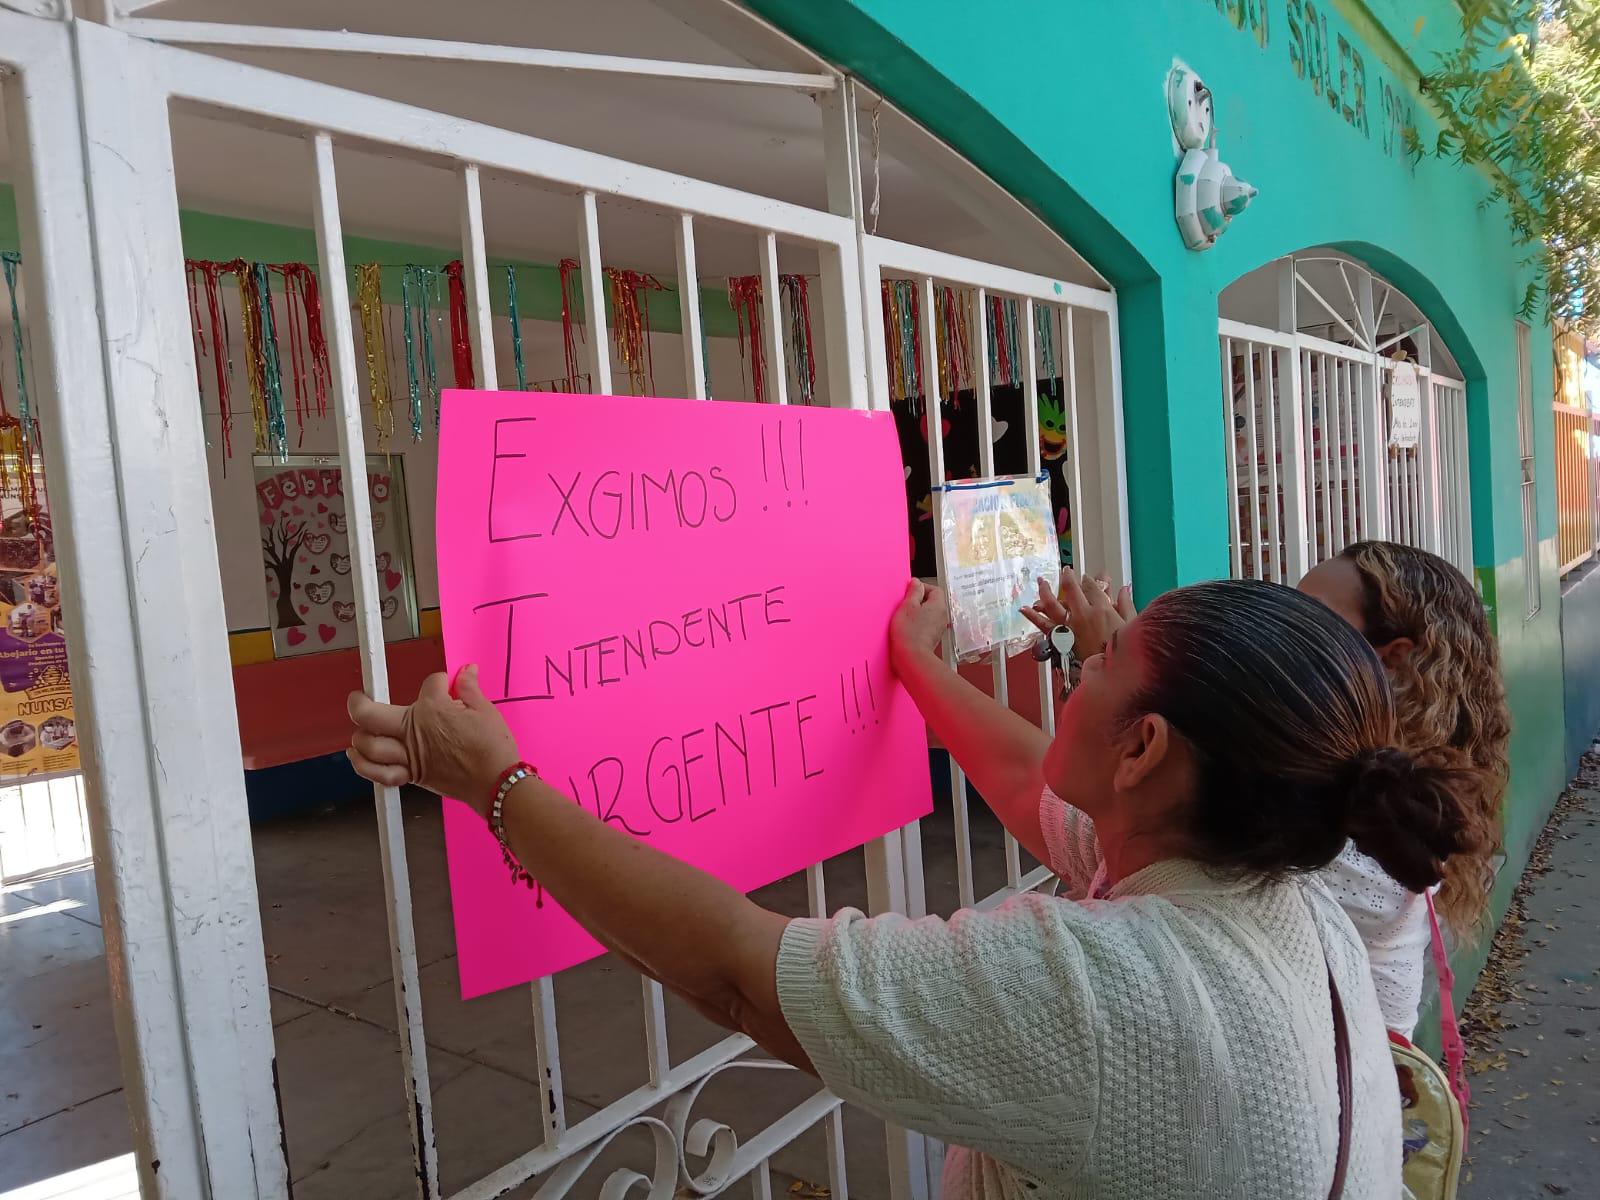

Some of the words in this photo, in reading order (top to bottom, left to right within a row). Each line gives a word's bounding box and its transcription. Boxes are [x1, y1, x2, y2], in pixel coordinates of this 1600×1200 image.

[489, 417, 738, 543] EXGIMOS
[472, 585, 792, 704] INTENDENTE
[566, 694, 826, 836] RGENTE
